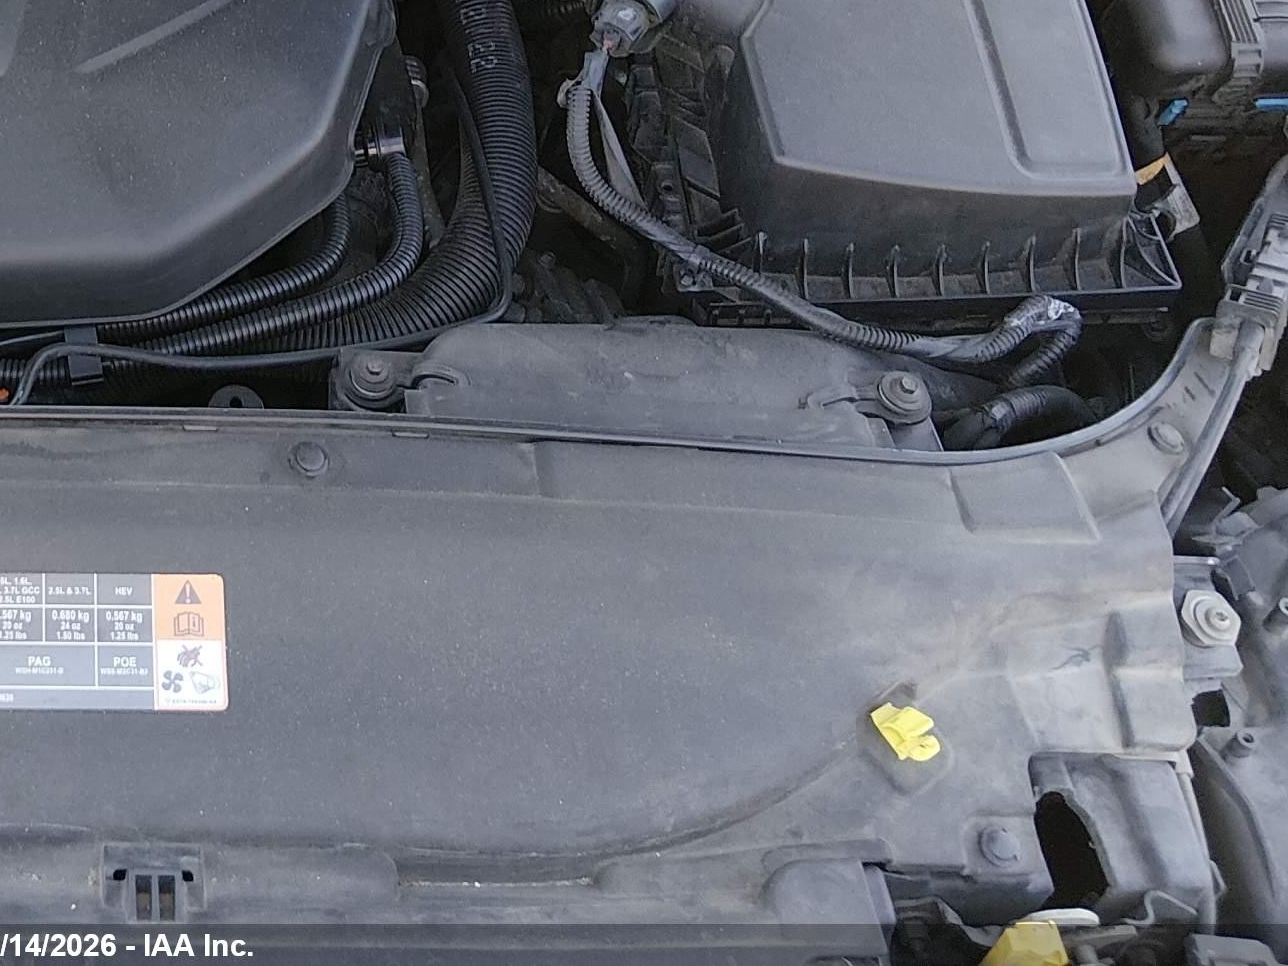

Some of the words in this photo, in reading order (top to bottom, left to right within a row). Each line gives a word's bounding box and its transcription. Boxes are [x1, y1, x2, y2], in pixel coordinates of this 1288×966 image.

[115, 587, 133, 595] HEV
[19, 610, 32, 622] kg
[78, 610, 89, 623] kg
[106, 611, 129, 621] 0.567
[131, 611, 143, 623] kg
[15, 631, 27, 639] lbs
[73, 631, 85, 640] lbs
[127, 632, 139, 640] lbs
[27, 656, 52, 666] PAG
[113, 656, 137, 667] POE
